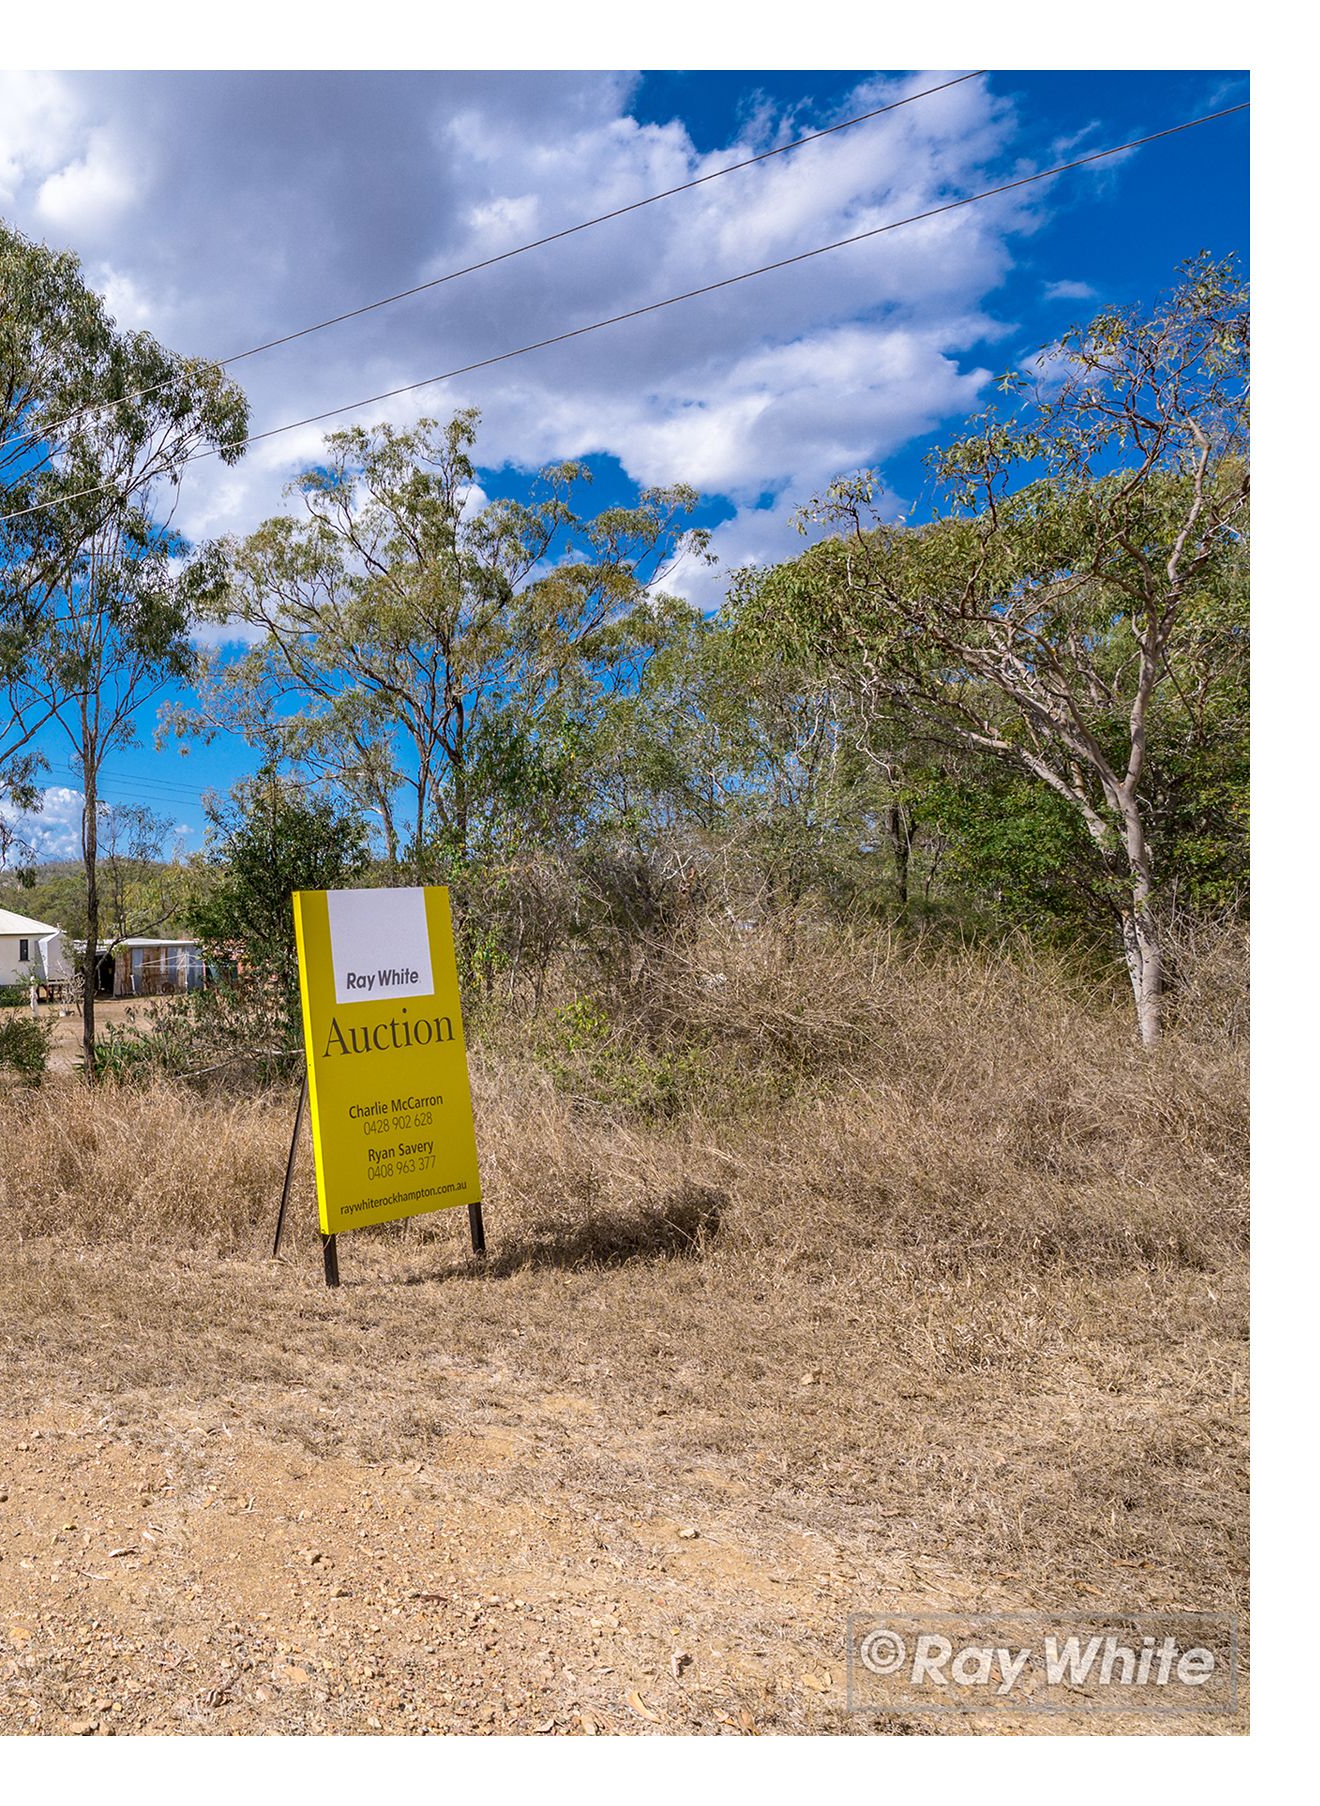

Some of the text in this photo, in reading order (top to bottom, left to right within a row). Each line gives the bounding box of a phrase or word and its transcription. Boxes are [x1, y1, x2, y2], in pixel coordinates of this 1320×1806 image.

[347, 968, 419, 991] Ray White
[322, 1008, 455, 1057] Auction
[349, 1094, 443, 1119] Charlie McCarron
[363, 1112, 433, 1135] 0428 902 628
[368, 1140, 434, 1164] Ryan Savery
[367, 1155, 436, 1181] 0408 963 377
[340, 1181, 467, 1215] raywhiterockhampton.com.au
